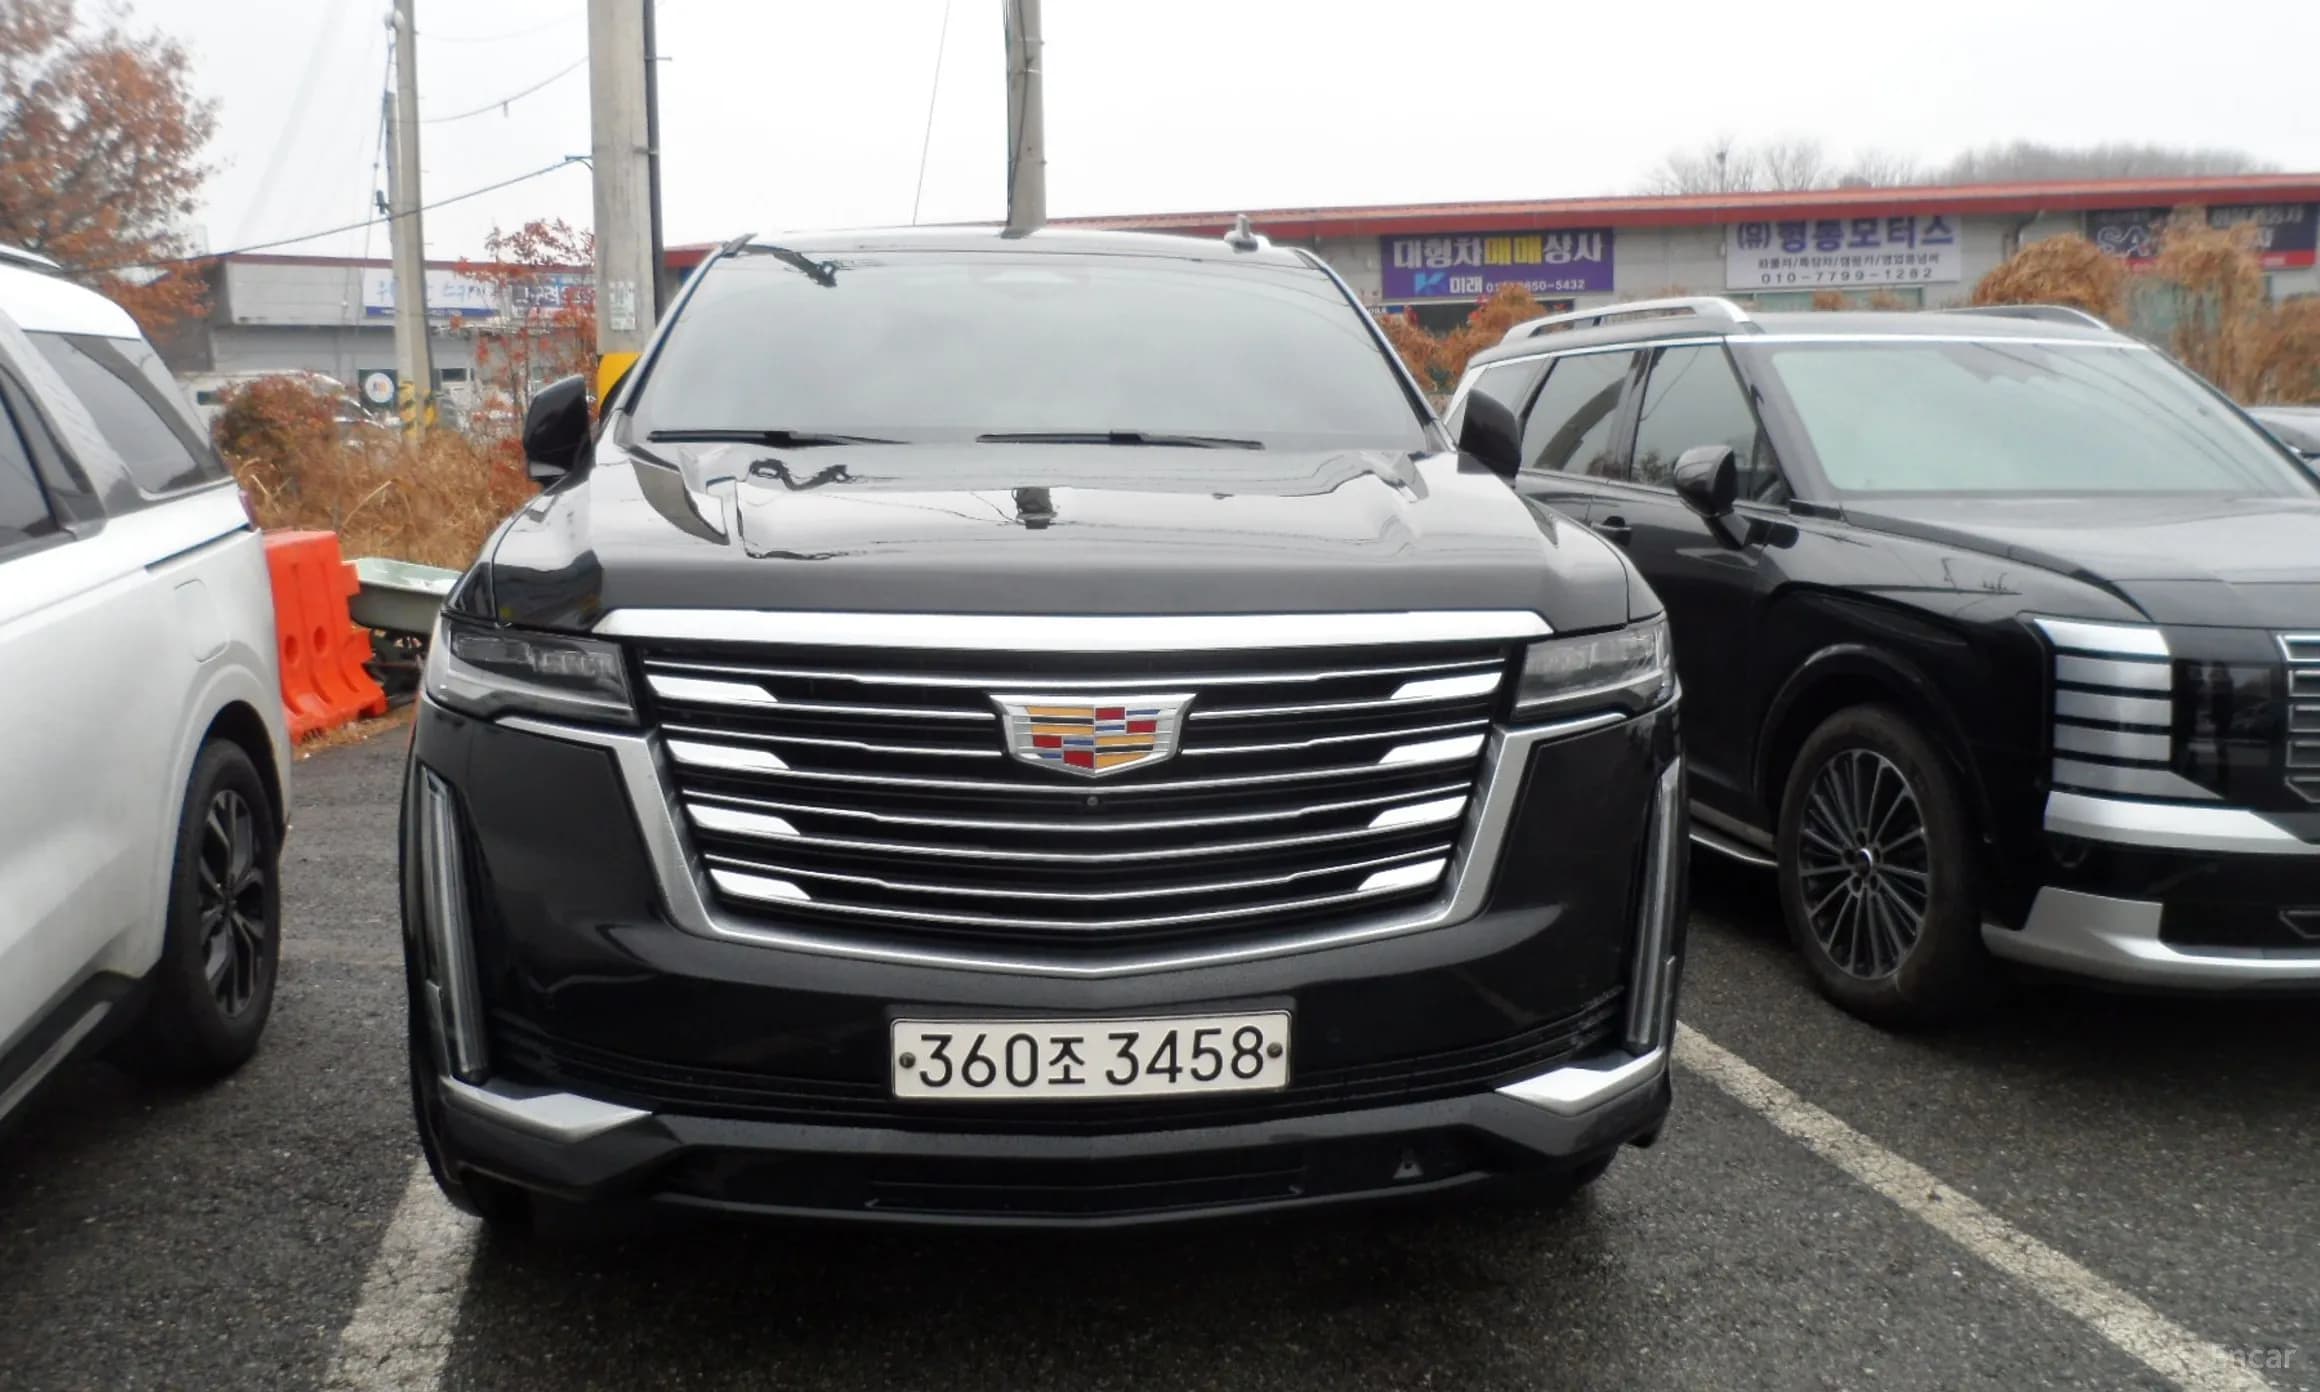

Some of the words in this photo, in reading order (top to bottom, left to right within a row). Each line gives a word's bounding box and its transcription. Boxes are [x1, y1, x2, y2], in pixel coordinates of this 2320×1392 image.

[1393, 231, 1602, 269] 대형차매매상사
[1450, 276, 1483, 294] 미래
[919, 1033, 1086, 1088] 360조
[1105, 1025, 1264, 1086] 3458
